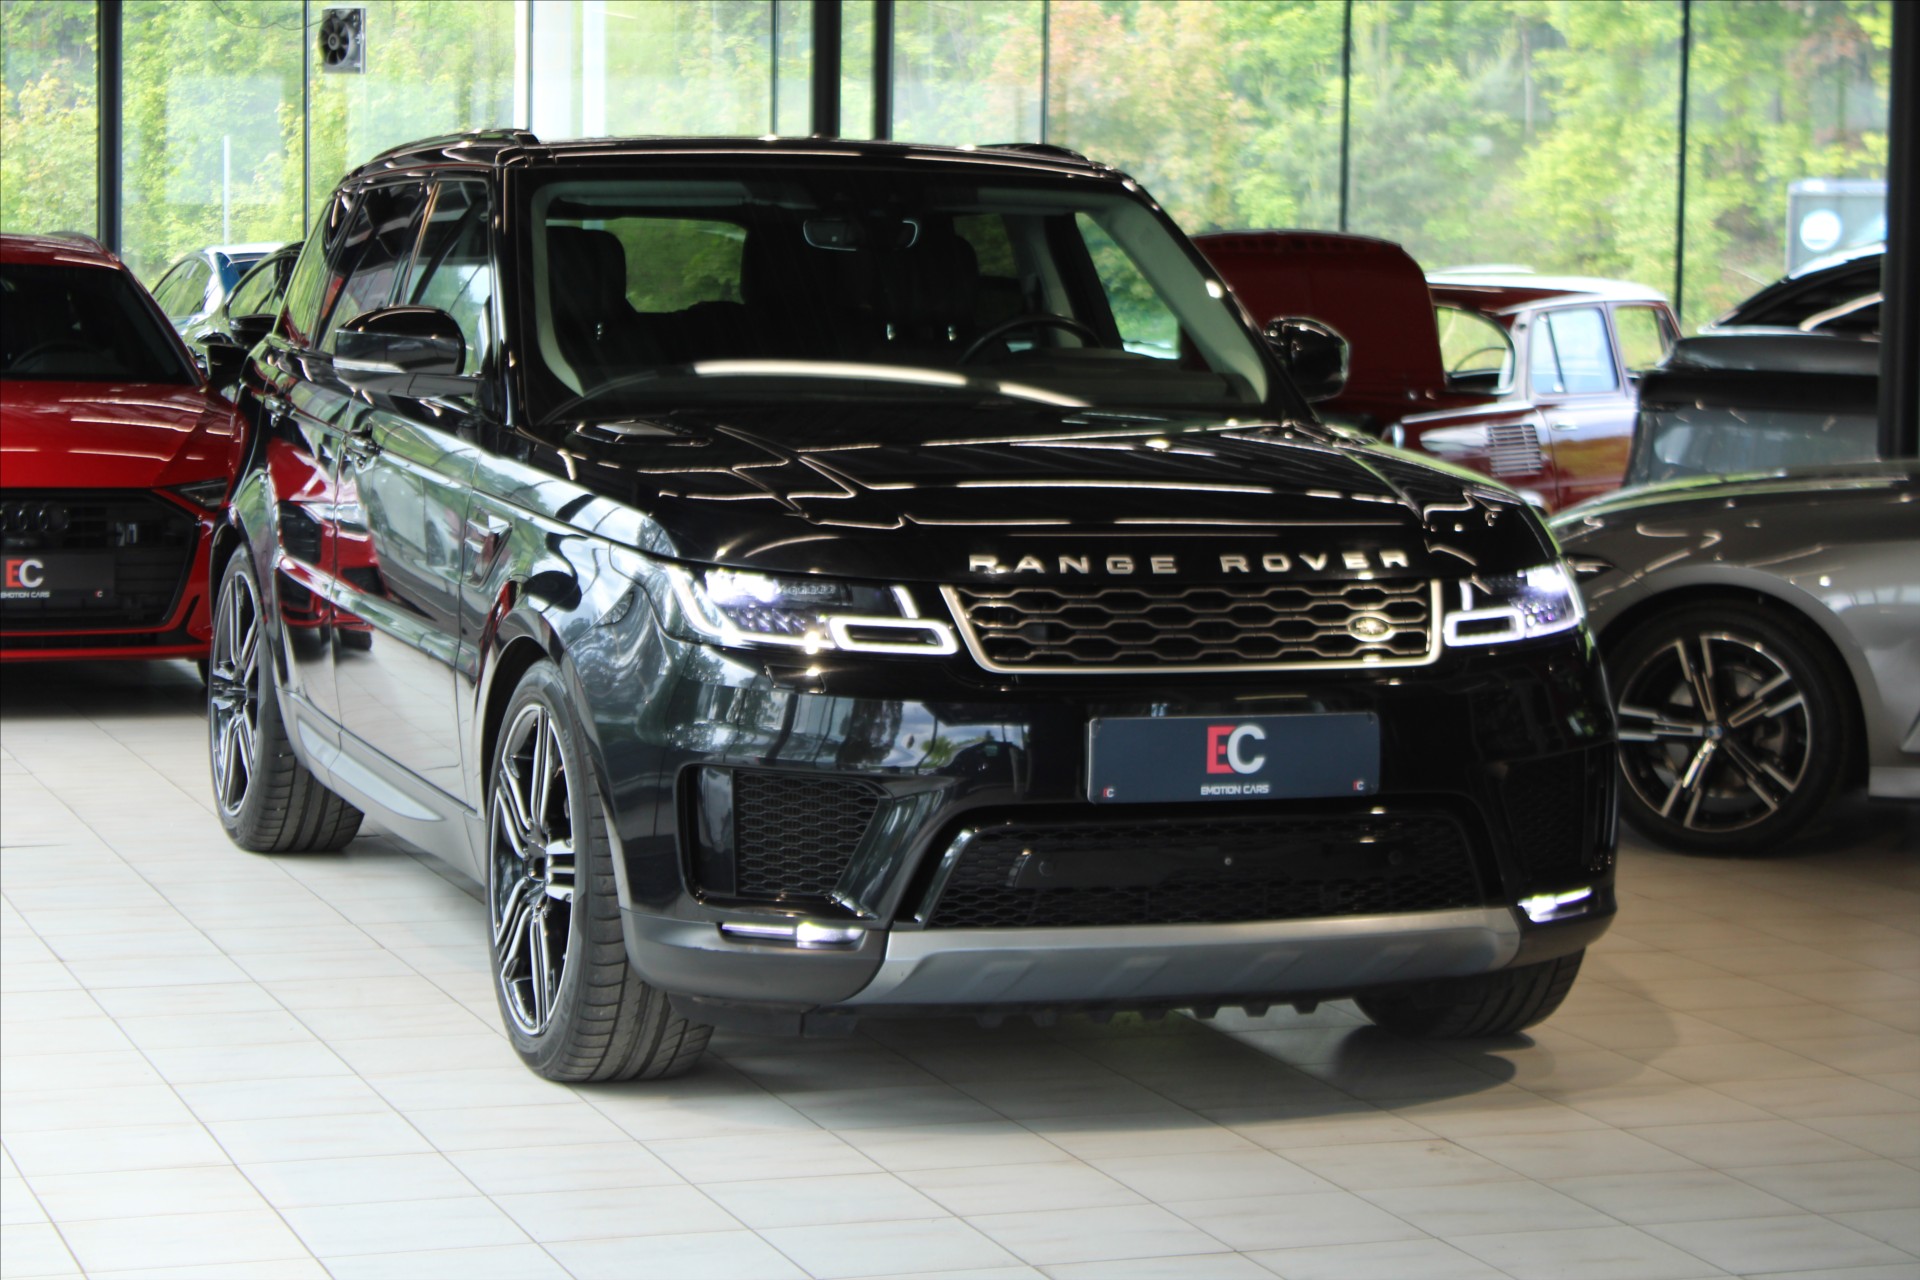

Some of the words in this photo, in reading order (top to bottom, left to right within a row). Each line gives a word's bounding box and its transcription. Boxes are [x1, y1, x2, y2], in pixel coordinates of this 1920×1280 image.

[5, 559, 44, 588] EC
[969, 555, 1177, 574] RANGE
[1219, 551, 1409, 573] ROVER
[1206, 725, 1266, 774] EC
[1200, 785, 1241, 796] EMOTION
[1243, 784, 1270, 794] CARS
